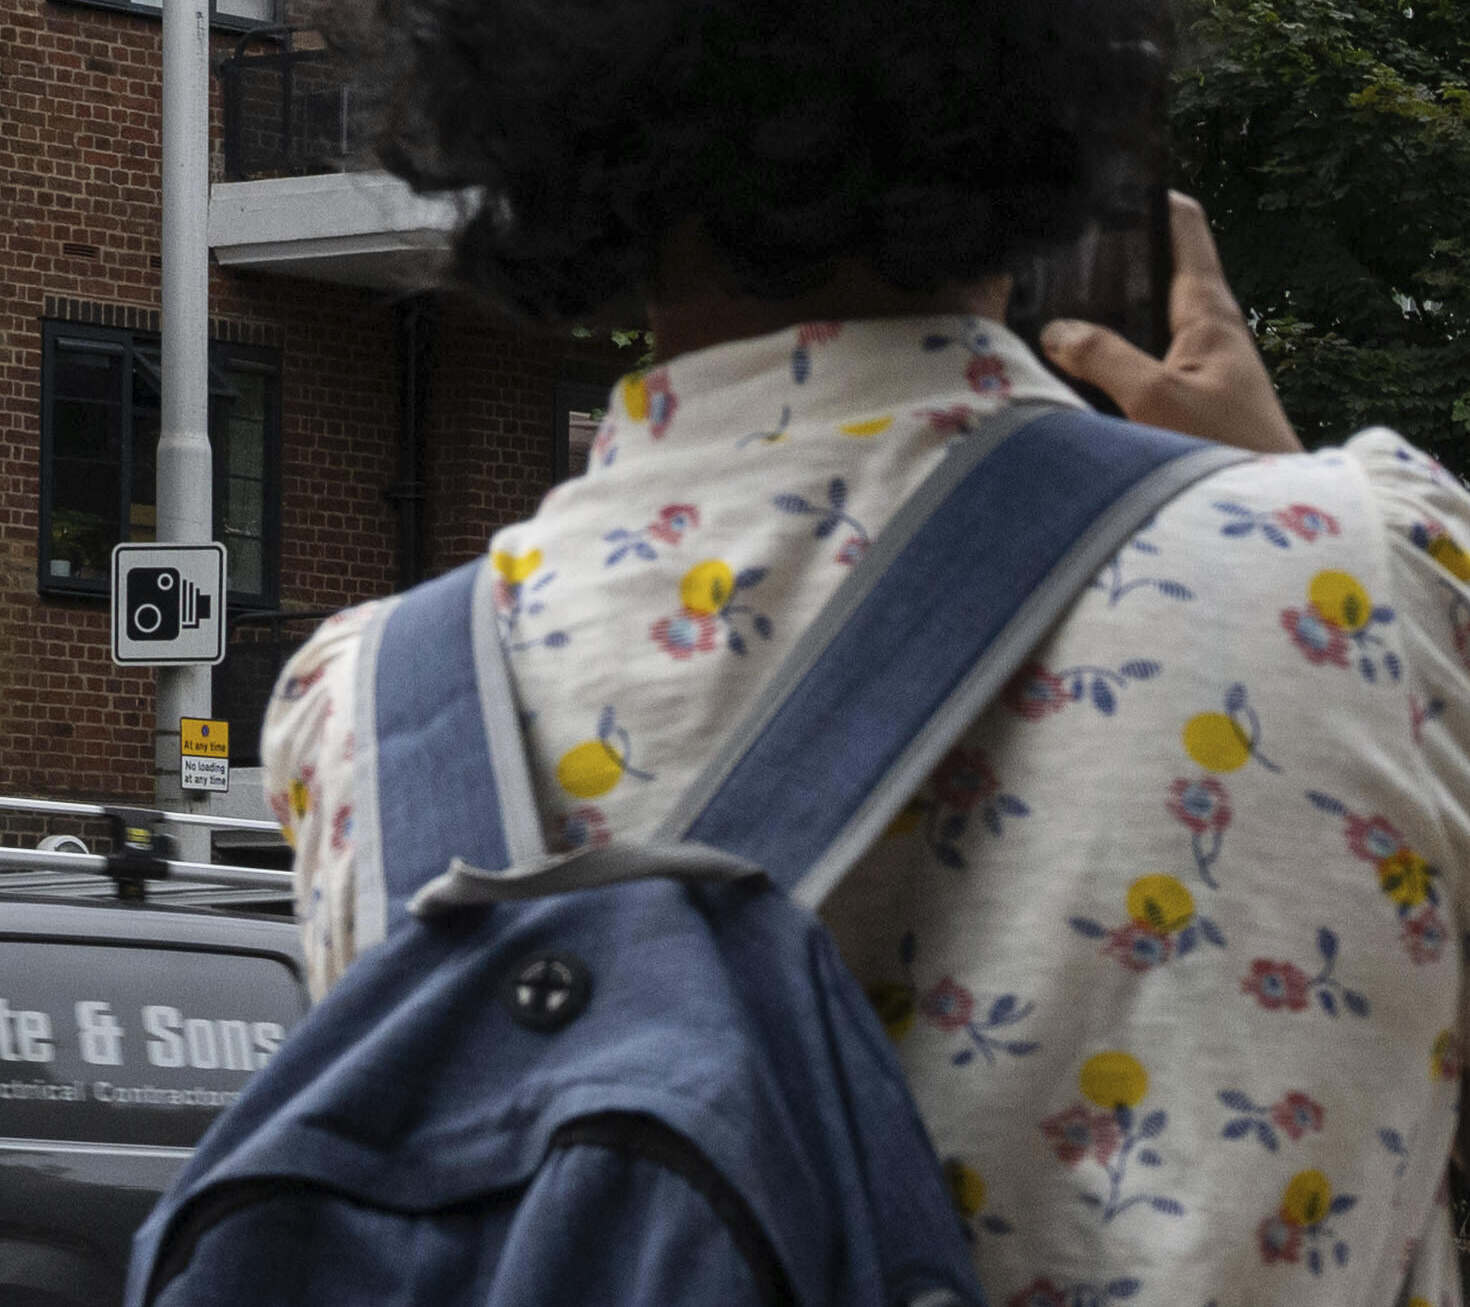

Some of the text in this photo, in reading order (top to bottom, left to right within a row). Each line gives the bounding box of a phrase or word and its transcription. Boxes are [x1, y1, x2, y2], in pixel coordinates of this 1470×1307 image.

[184, 740, 226, 753] At any time
[185, 760, 225, 774] No loading
[184, 774, 226, 786] at any time
[74, 1000, 125, 1066] &
[142, 1004, 287, 1072] Sons
